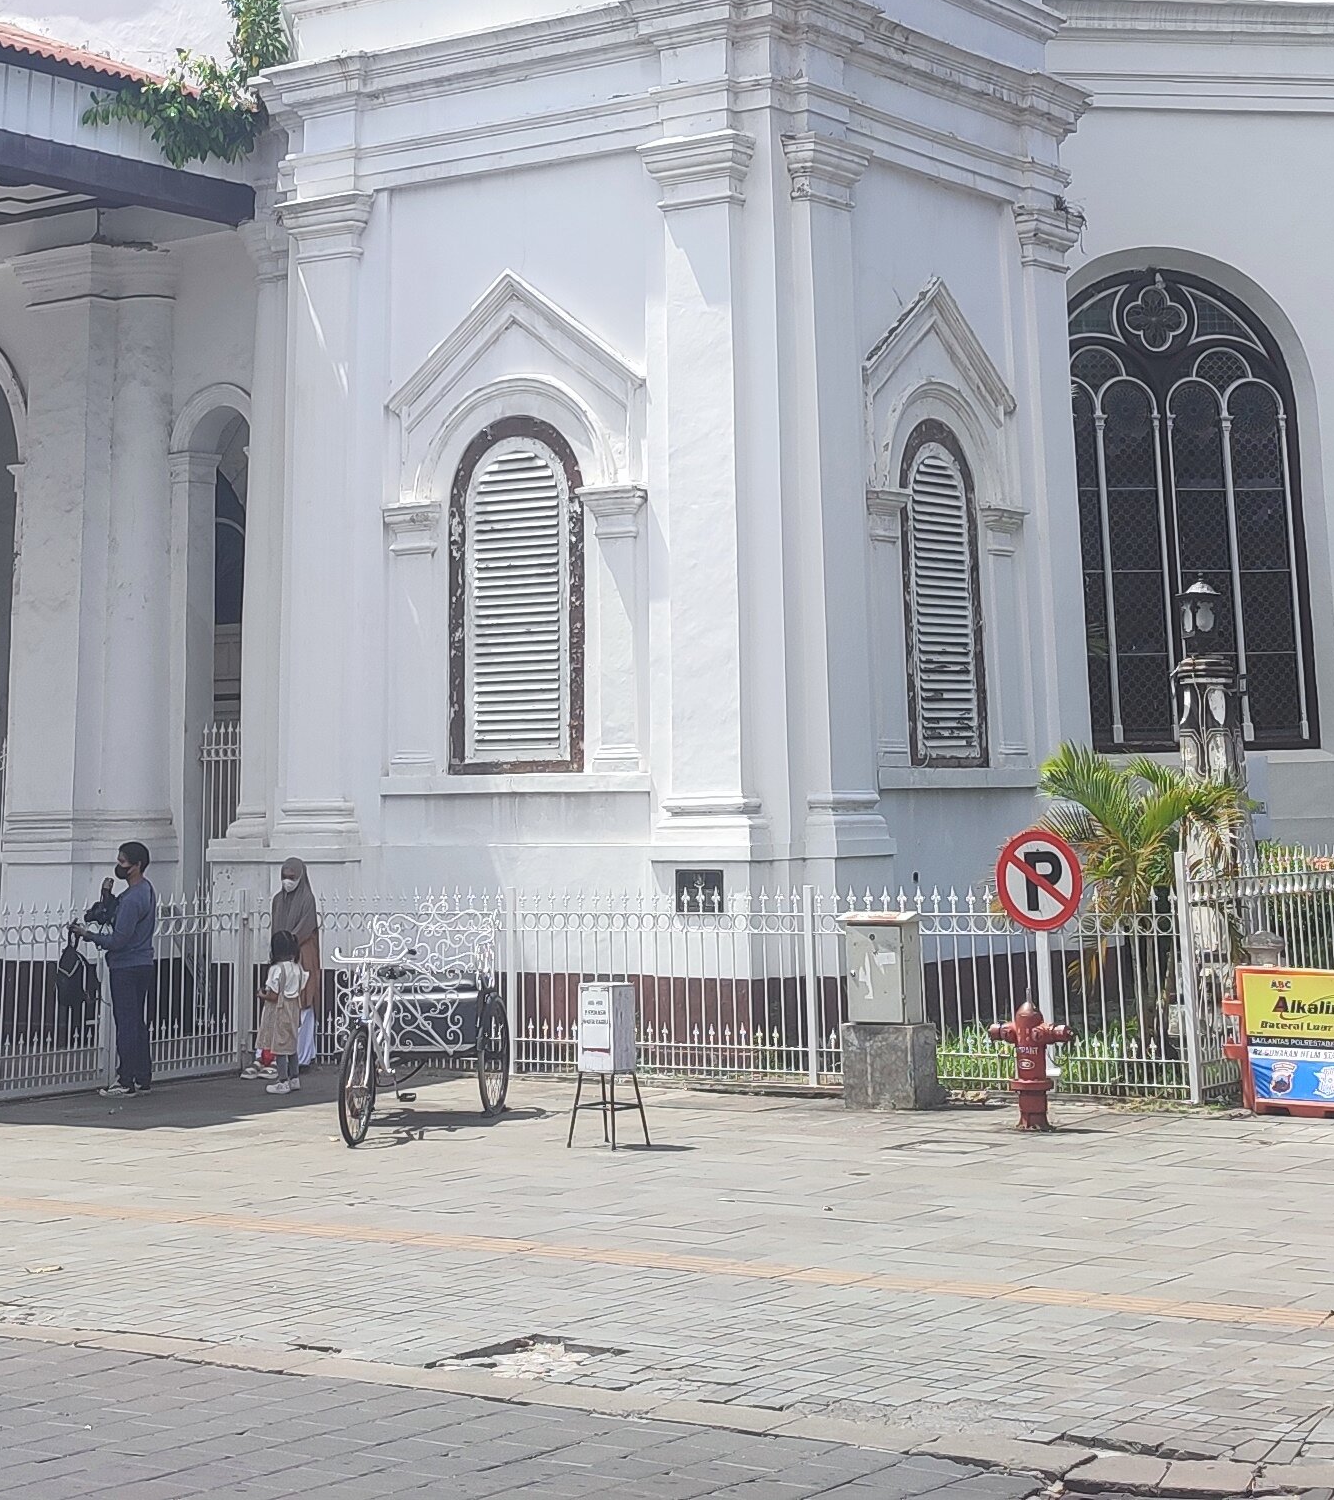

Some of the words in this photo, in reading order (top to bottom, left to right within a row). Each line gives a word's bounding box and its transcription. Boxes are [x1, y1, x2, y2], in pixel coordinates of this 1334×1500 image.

[1024, 851, 1062, 911] P
[1271, 980, 1291, 989] ABC
[1307, 1022, 1333, 1031] Luar
